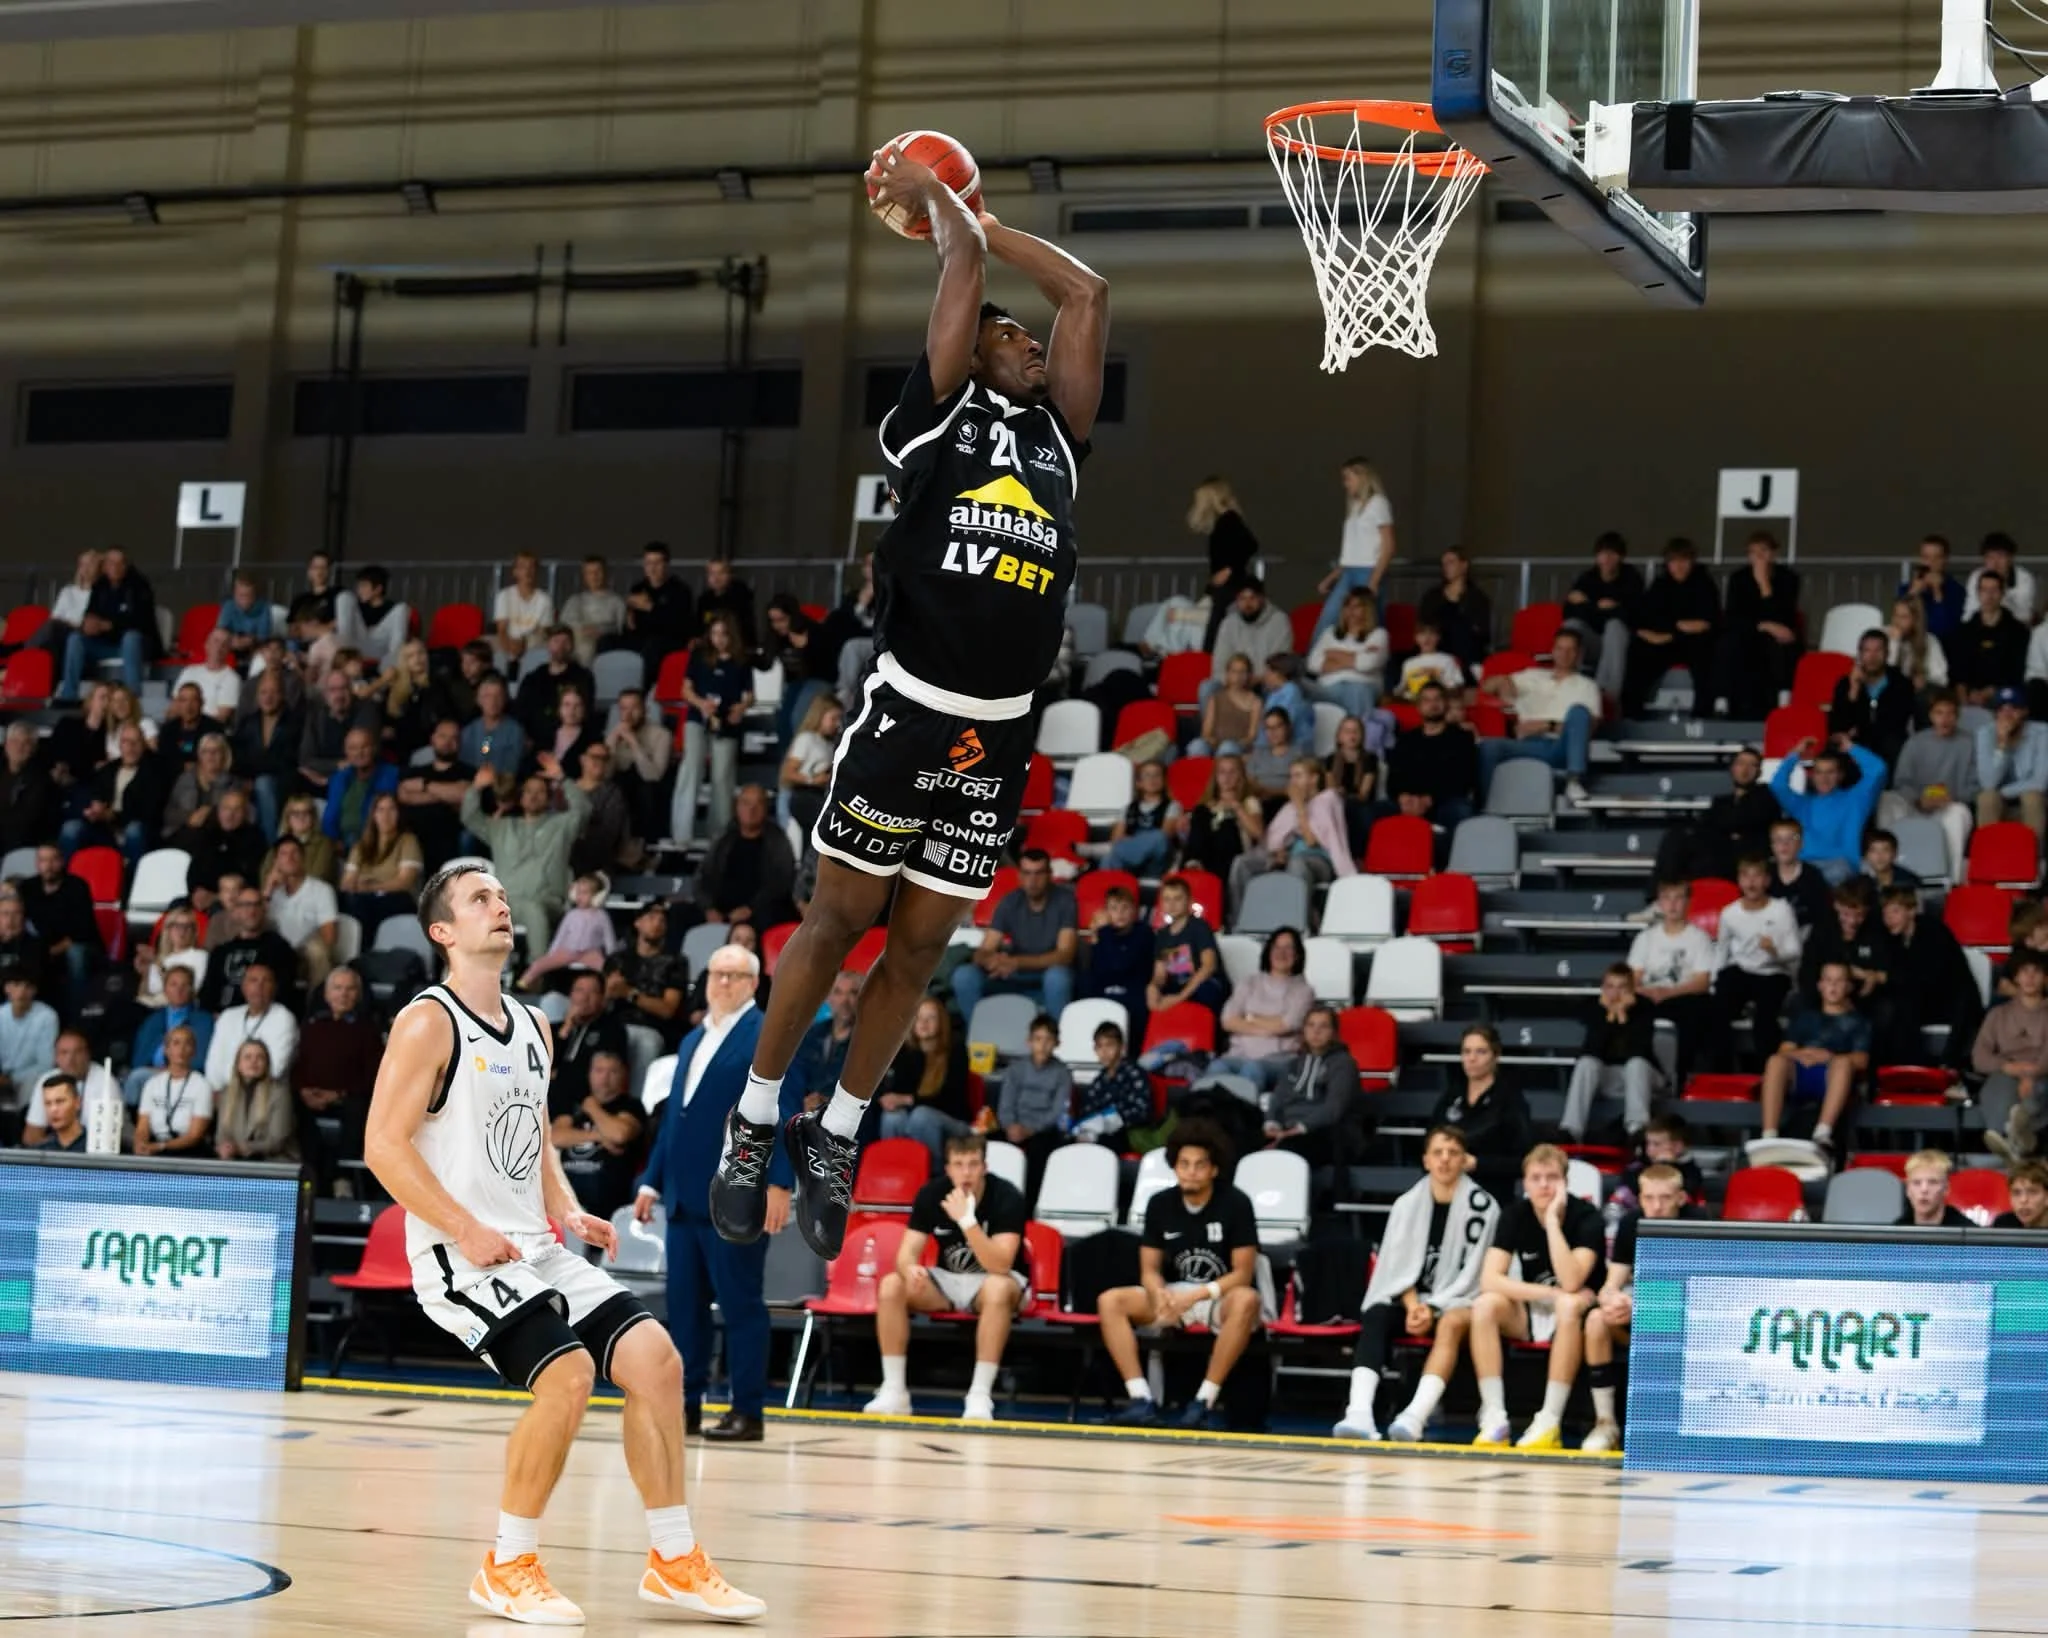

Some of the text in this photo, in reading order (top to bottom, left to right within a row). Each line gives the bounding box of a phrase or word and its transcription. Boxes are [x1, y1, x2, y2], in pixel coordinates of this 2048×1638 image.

[200, 488, 223, 521] L
[1742, 474, 1772, 512] J
[949, 501, 1058, 549] aimasa
[848, 795, 927, 832] Europcar
[1520, 1027, 1533, 1045] 5
[527, 1042, 544, 1079] 4
[81, 1231, 230, 1288] SANART
[491, 1277, 523, 1308] 4
[1741, 1307, 1932, 1372] SANART
